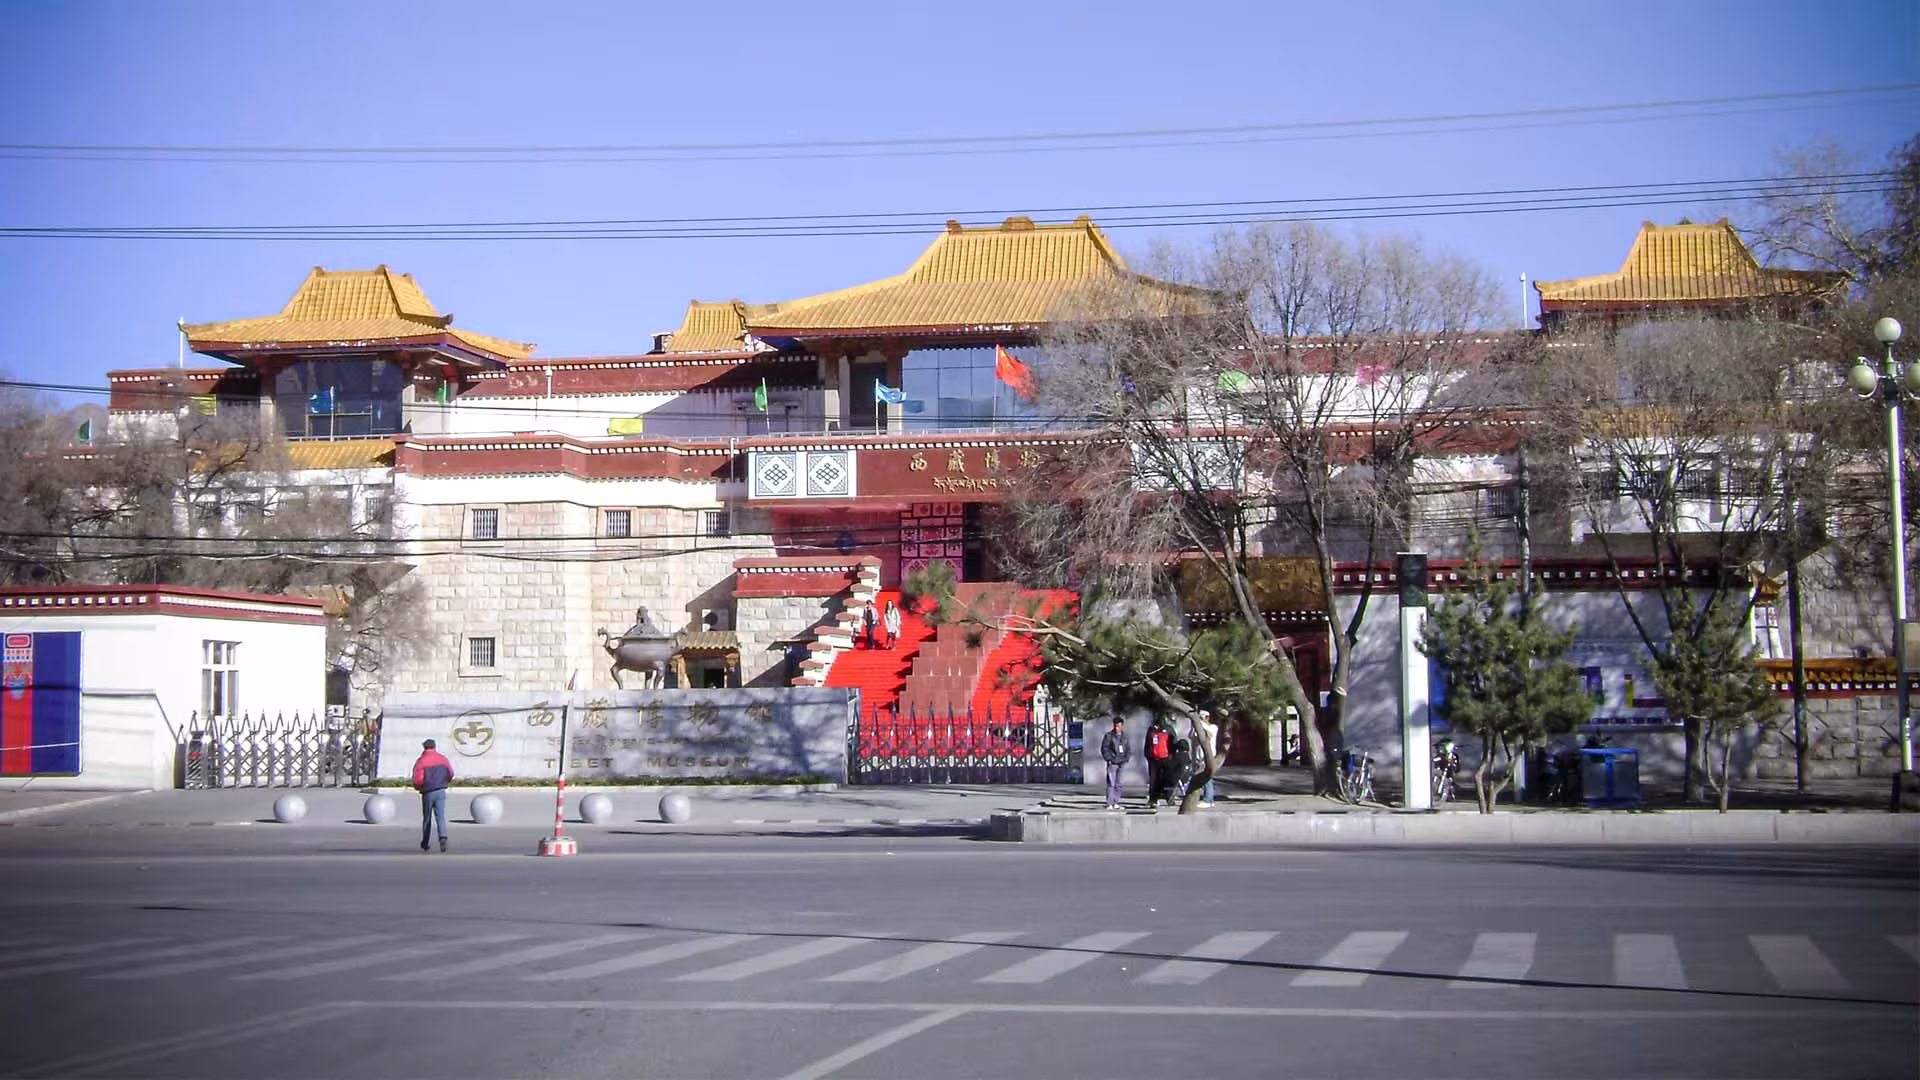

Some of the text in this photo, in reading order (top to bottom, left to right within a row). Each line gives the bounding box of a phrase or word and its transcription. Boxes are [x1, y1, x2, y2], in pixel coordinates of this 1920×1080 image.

[910, 449, 1070, 472] 西藏博物
[544, 756, 749, 769] TBET MUSEUM
